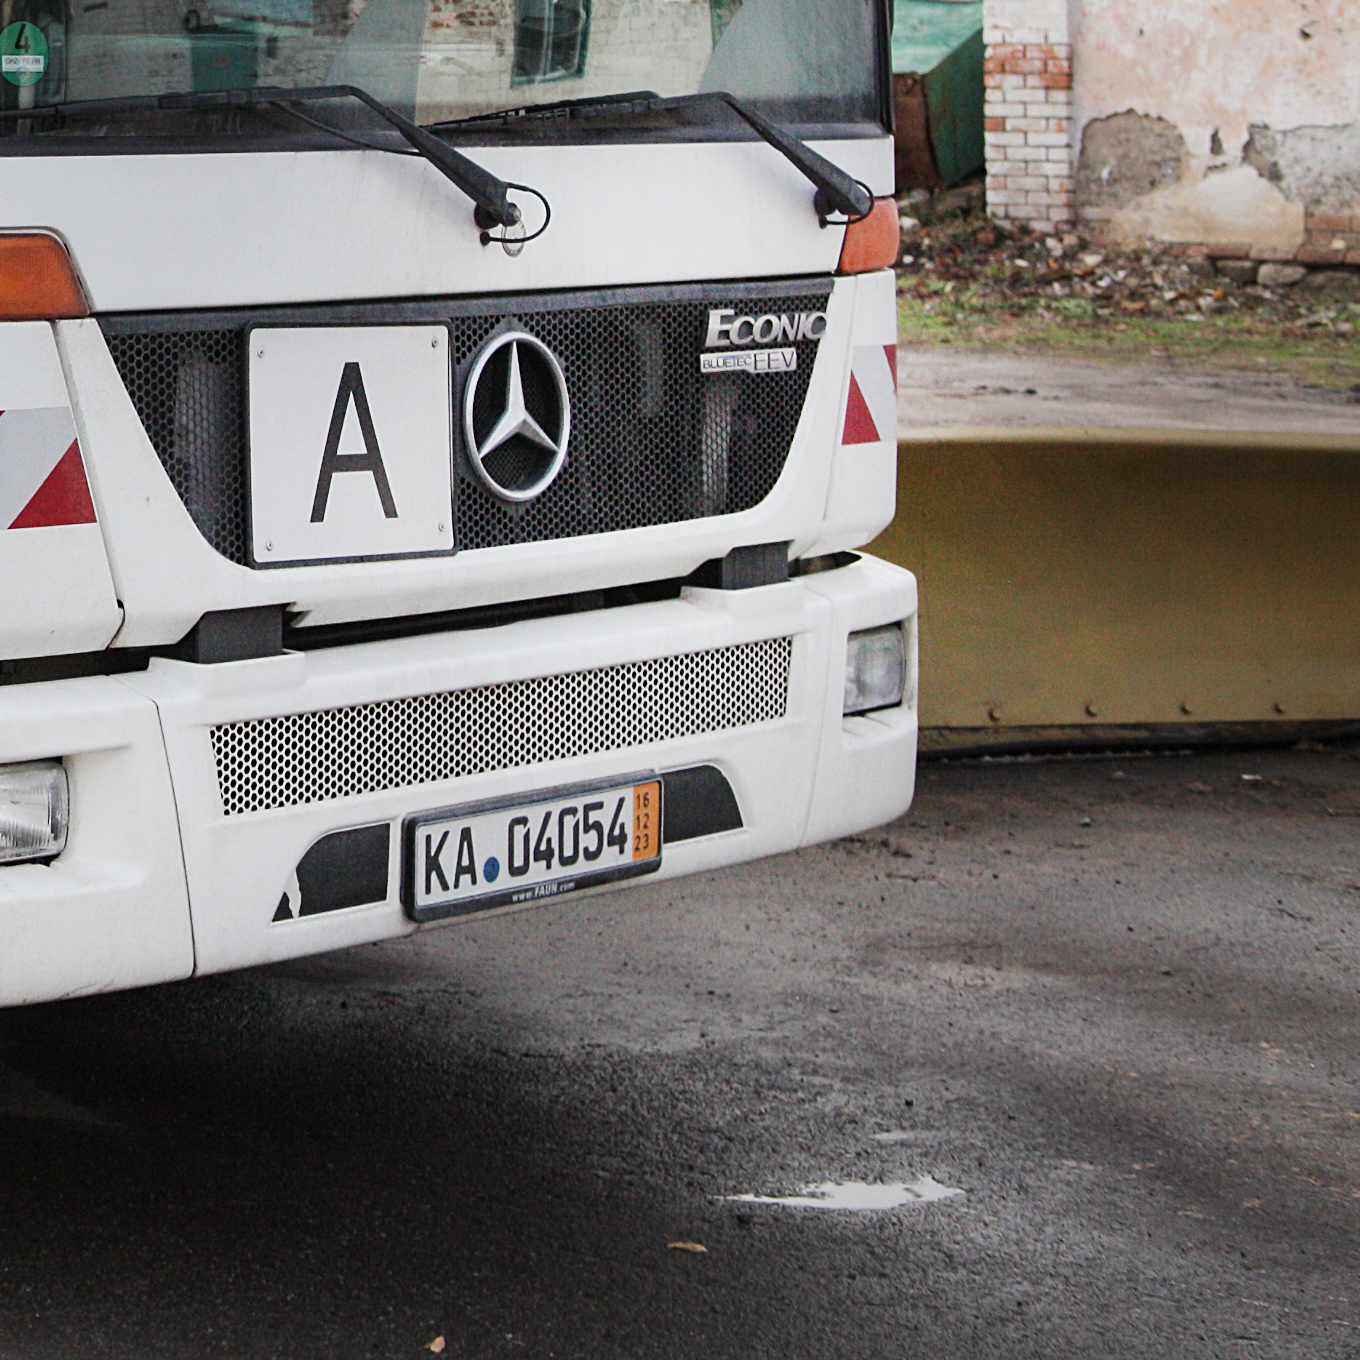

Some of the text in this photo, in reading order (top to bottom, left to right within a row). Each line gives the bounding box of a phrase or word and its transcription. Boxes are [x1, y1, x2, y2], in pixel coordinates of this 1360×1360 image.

[15, 23, 30, 53] 4
[702, 351, 795, 371] BLUETEC EEV
[310, 361, 399, 524] A
[636, 791, 650, 809] 16
[635, 813, 650, 830] 12
[425, 796, 628, 895] KA 04054
[634, 834, 649, 852] 23
